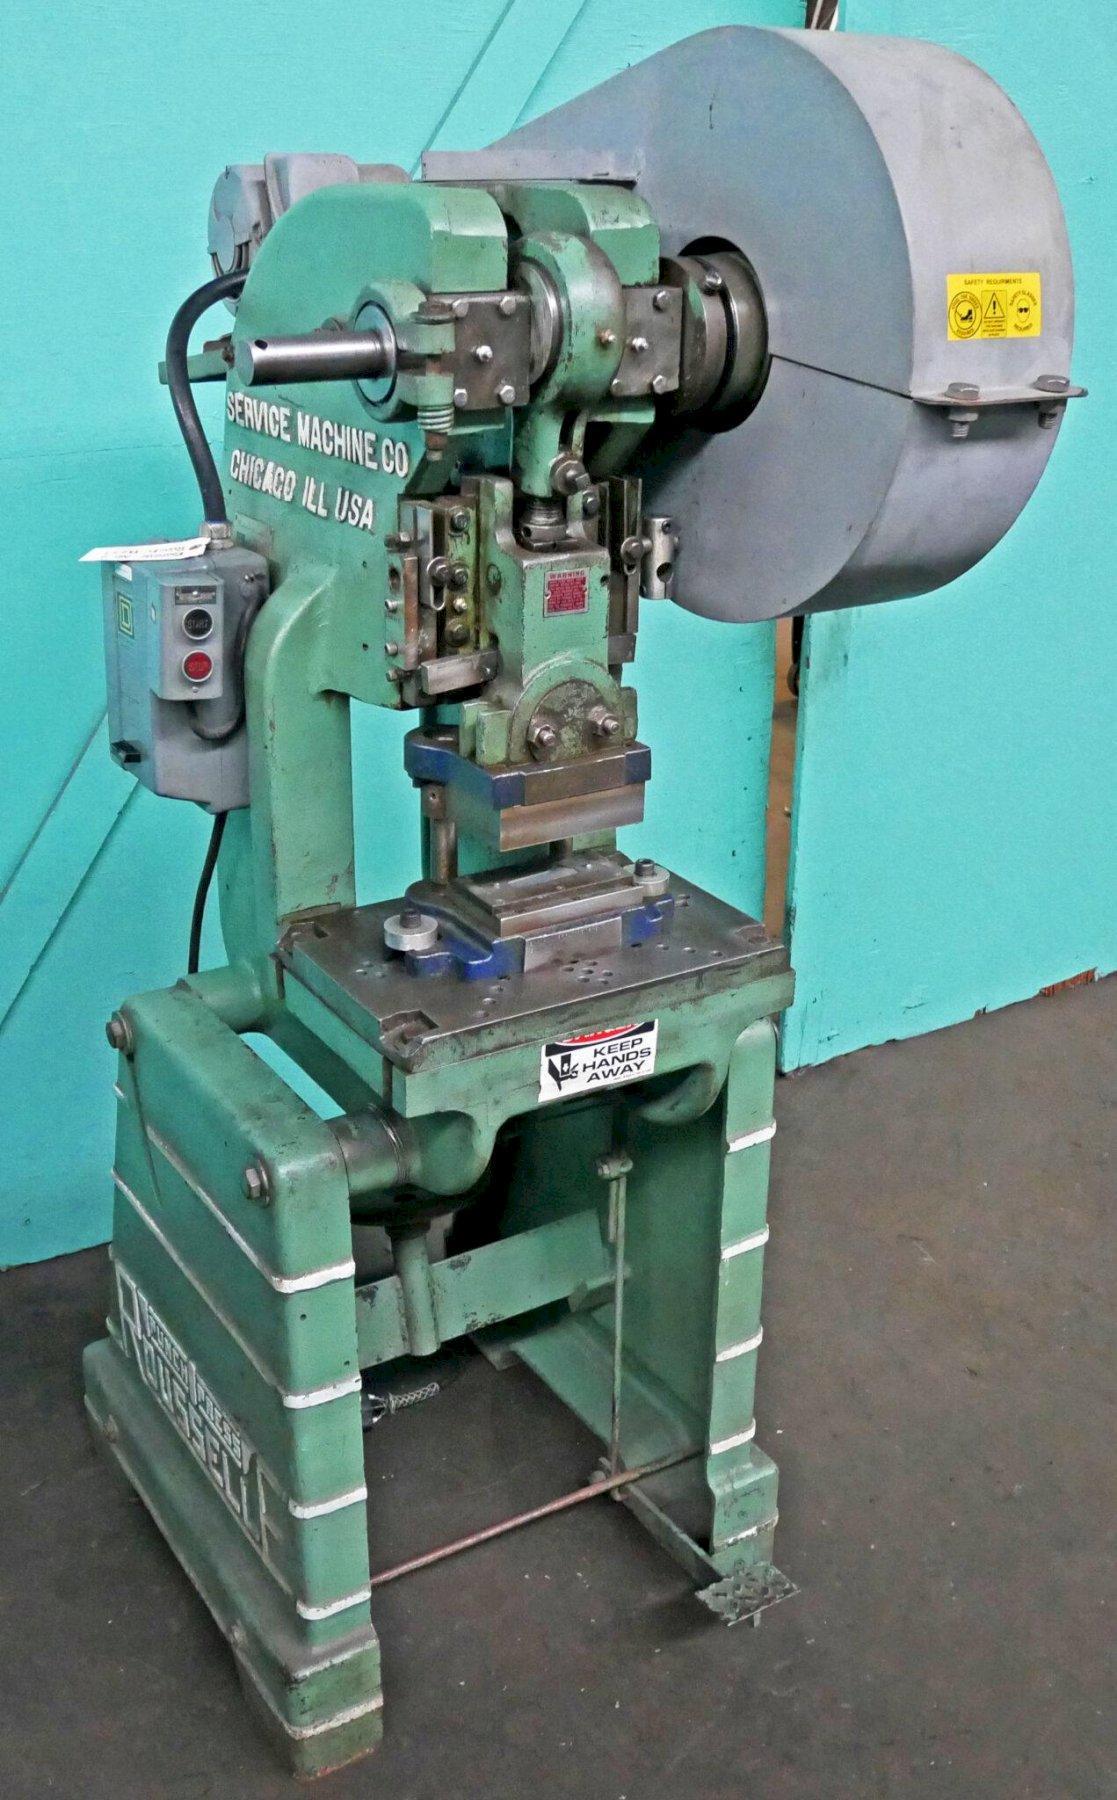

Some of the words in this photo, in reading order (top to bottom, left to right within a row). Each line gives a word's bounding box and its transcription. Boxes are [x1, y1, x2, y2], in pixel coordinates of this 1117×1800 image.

[227, 391, 291, 442] SERVICE
[297, 411, 378, 470] MACHINE
[381, 437, 409, 478] CO
[230, 449, 296, 502] CHICAGO
[302, 476, 328, 517] ILL
[335, 486, 374, 530] USA
[549, 570, 585, 579] WARNING
[582, 1047, 651, 1072] HANDS
[593, 1037, 643, 1058] KEEP
[586, 1060, 646, 1083] AWAY
